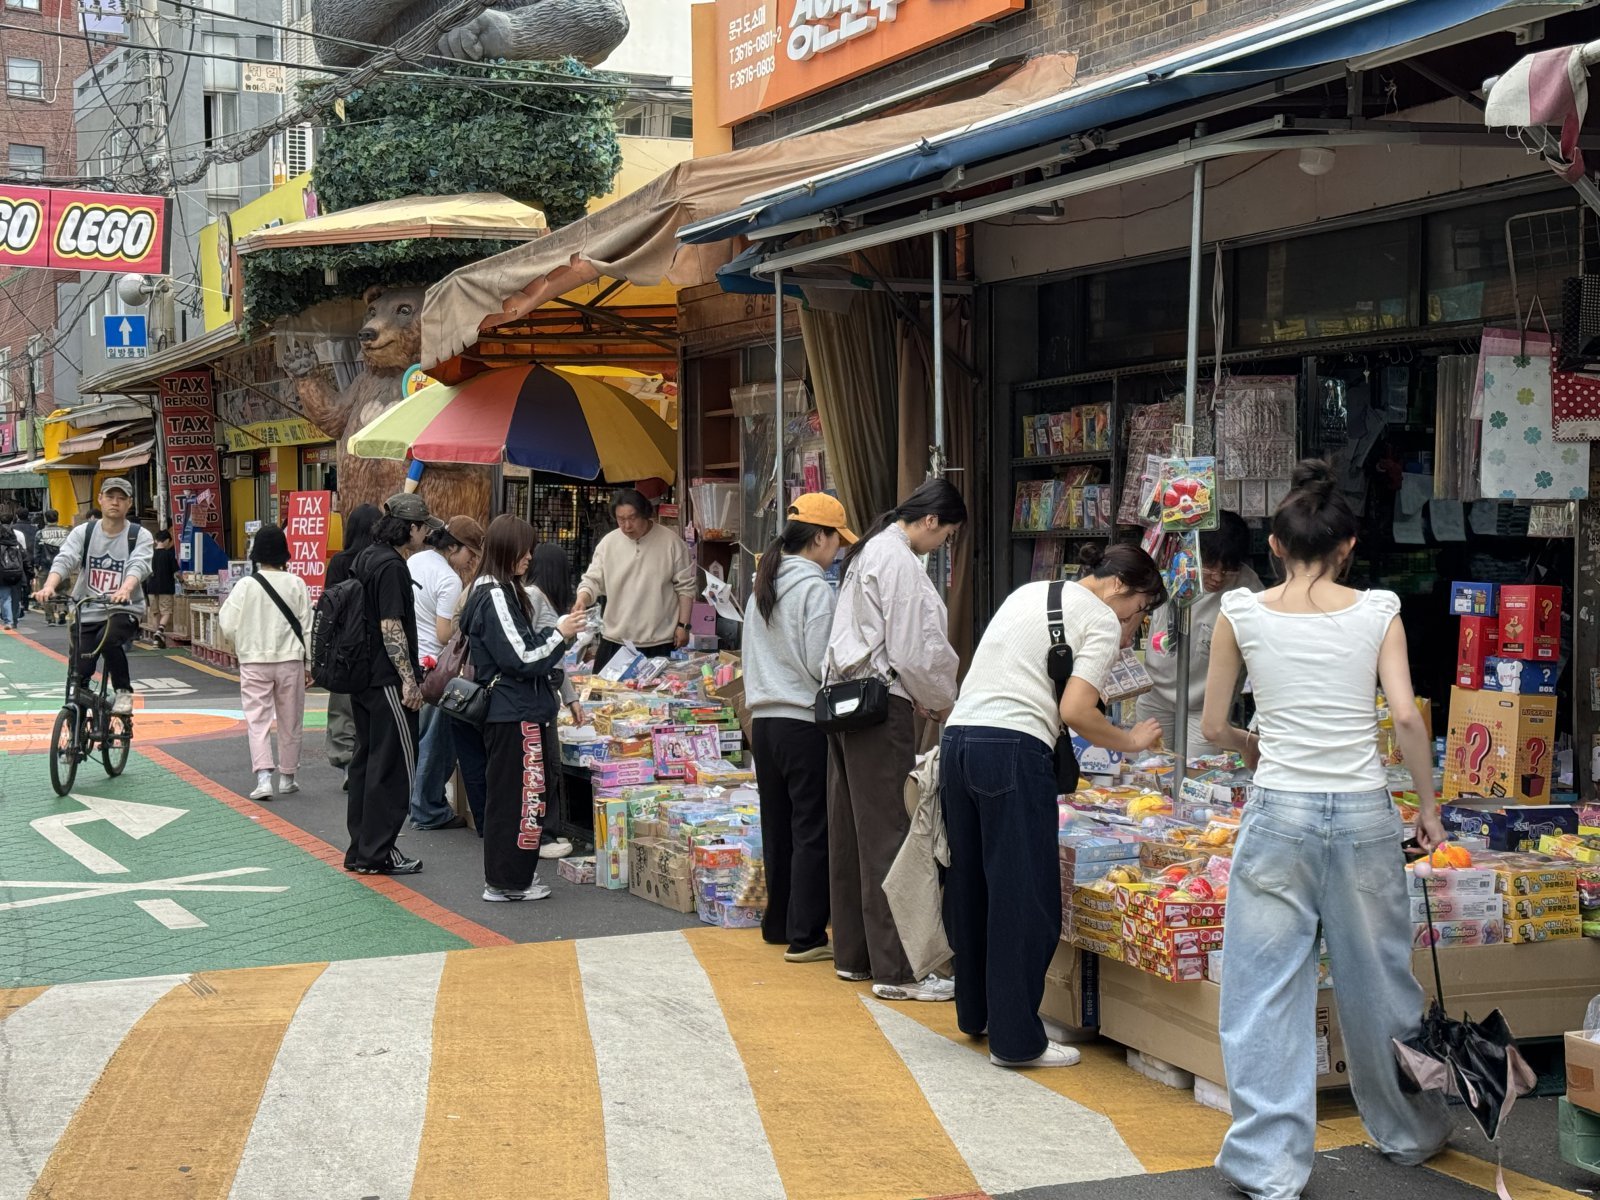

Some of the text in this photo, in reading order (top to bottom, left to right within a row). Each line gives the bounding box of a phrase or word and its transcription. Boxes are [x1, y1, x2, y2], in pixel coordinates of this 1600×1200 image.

[729, 4, 767, 40] 문구 도소매
[56, 205, 152, 260] LEGO
[165, 377, 206, 394] TAX
[165, 396, 209, 407] REFUND
[168, 416, 210, 433] TAX
[168, 435, 212, 446] REFUND
[171, 455, 213, 472] TAX
[172, 474, 216, 485] REFUND
[175, 493, 216, 511] TX
[296, 496, 322, 515] TAX
[42, 529, 67, 538] WHITE
[291, 517, 325, 536] FREE
[293, 541, 319, 560] TAX
[91, 569, 119, 592] NFL
